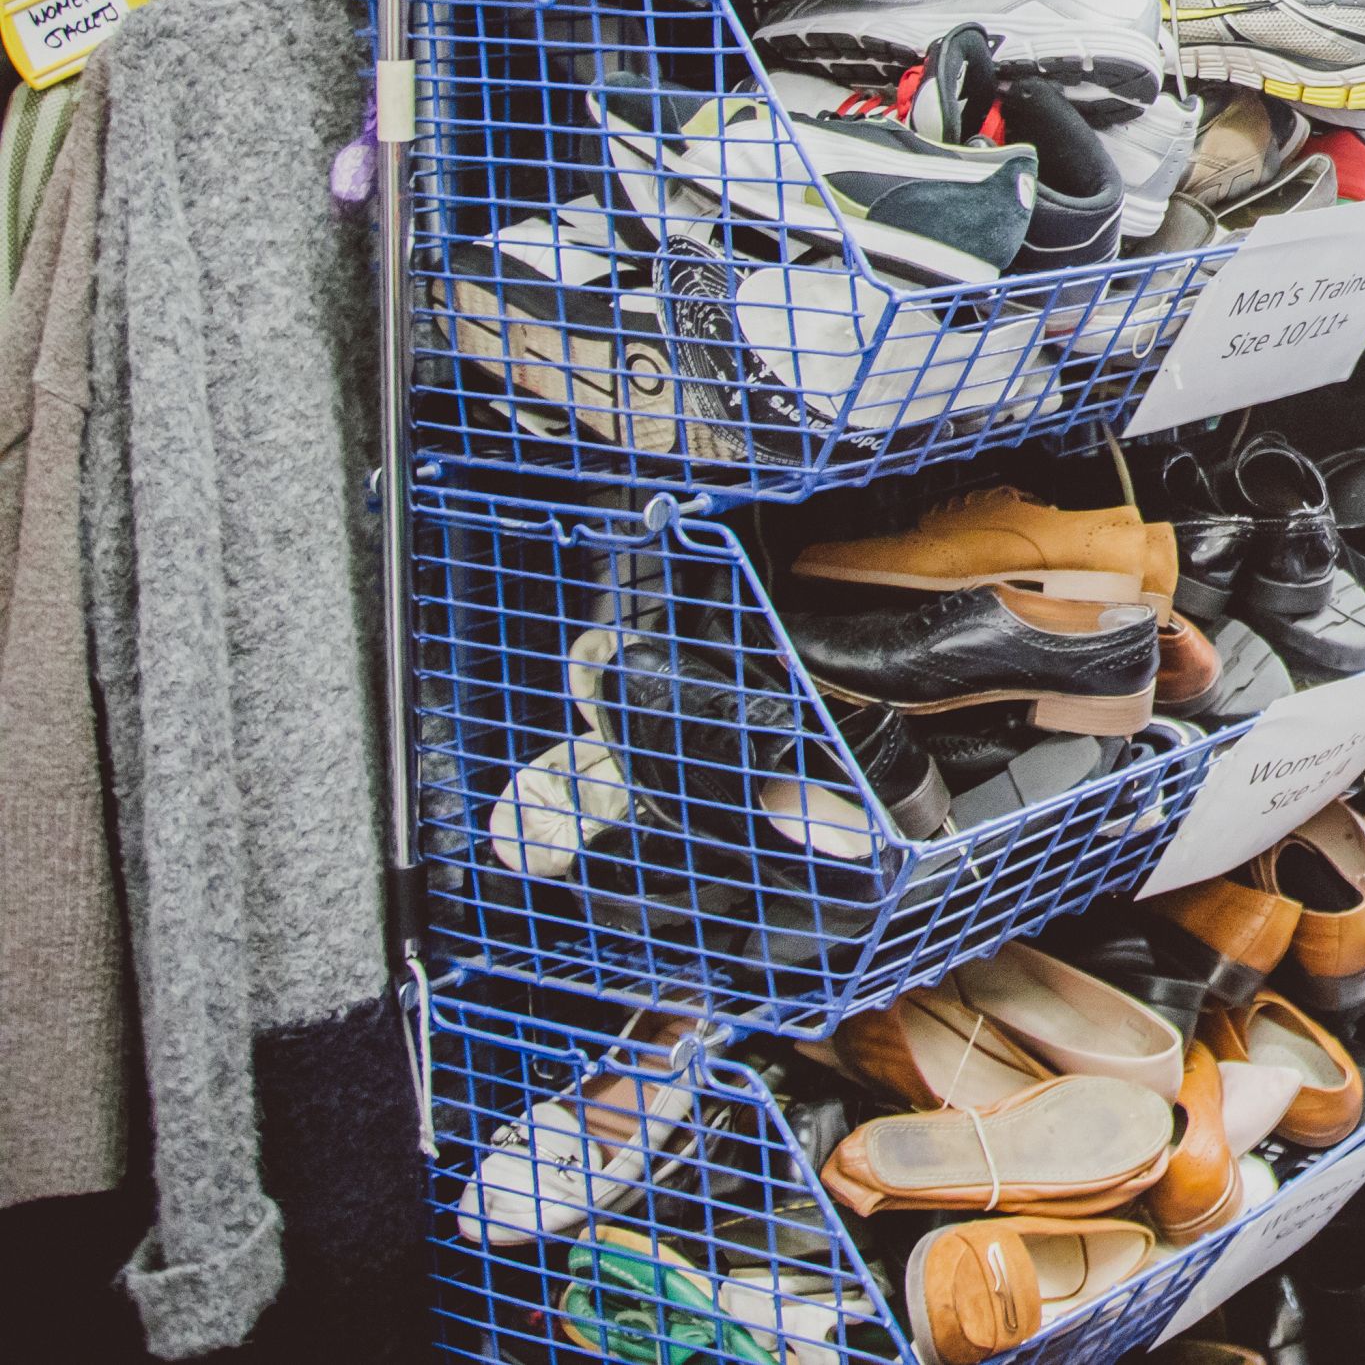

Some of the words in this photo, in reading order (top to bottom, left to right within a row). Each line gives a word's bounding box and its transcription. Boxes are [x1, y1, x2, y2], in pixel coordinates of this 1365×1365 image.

[43, 2, 119, 49] JACKETS
[1228, 281, 1300, 318] Men's
[1220, 333, 1270, 360] Size
[1273, 314, 1350, 348] 10/11+
[1248, 733, 1361, 786] Women's
[1261, 783, 1315, 815] Size
